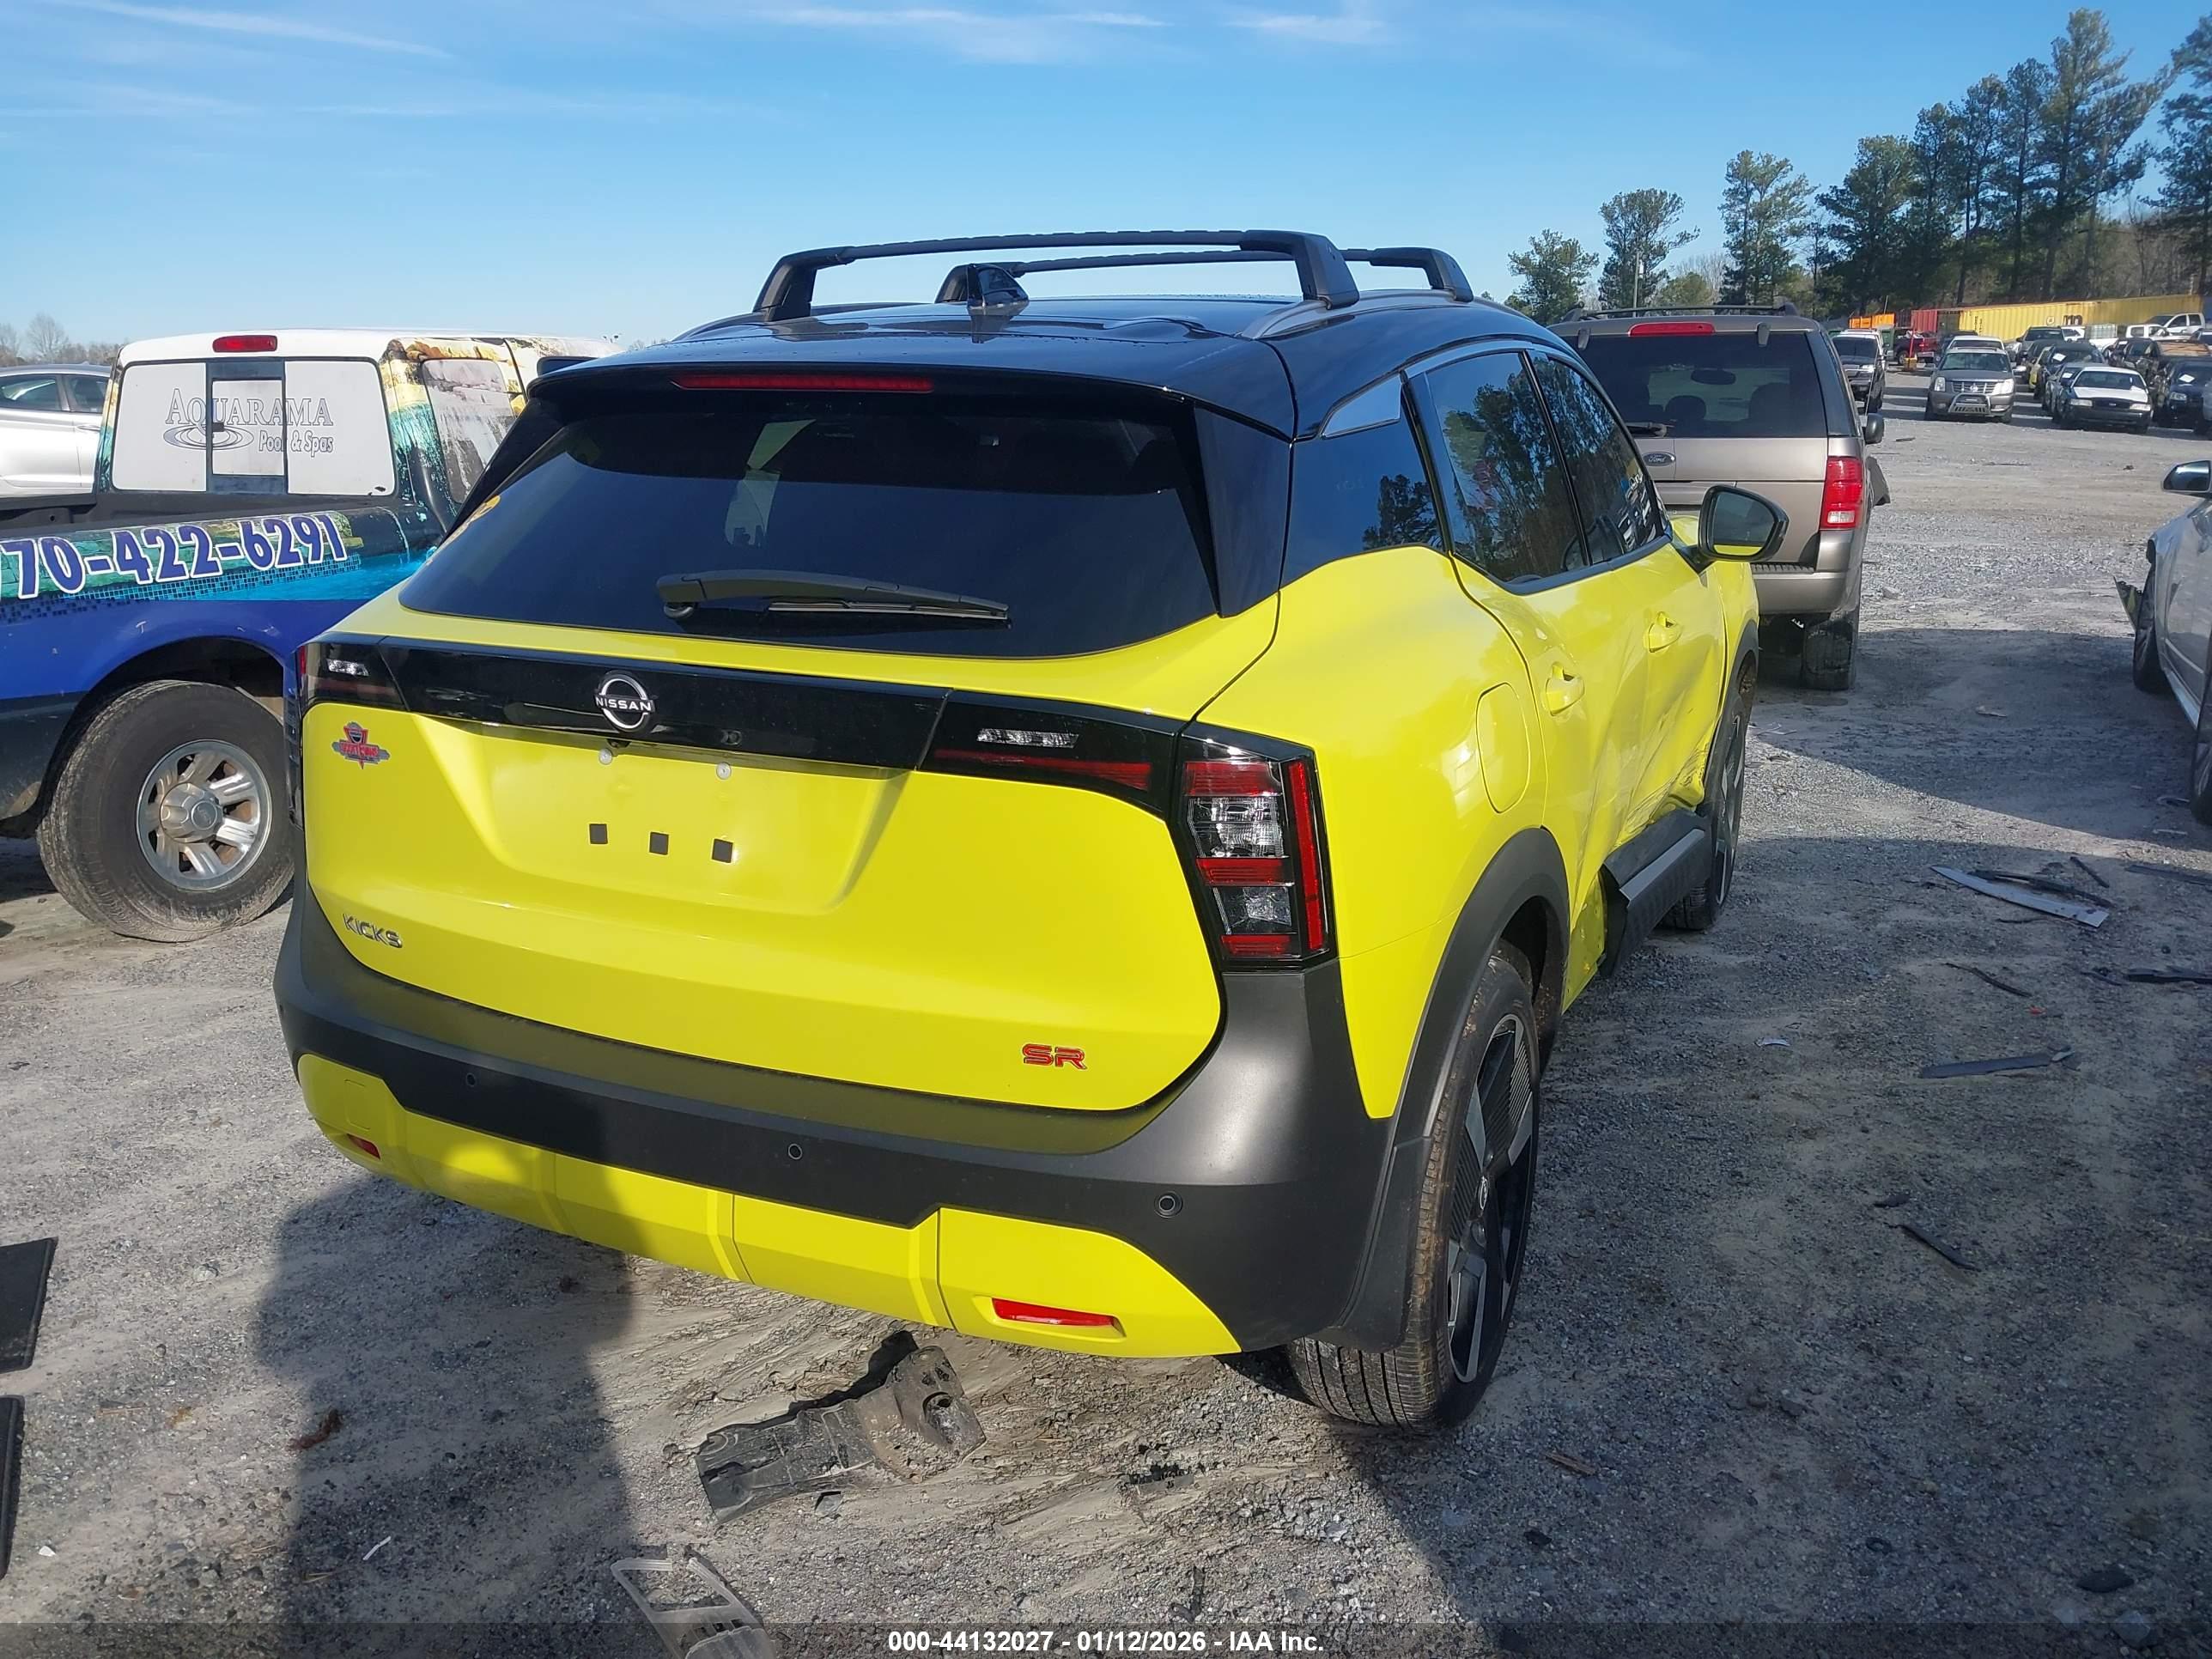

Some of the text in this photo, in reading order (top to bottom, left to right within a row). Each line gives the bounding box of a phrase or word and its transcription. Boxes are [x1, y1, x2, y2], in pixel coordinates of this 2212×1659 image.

[165, 387, 334, 435] AQUARAMA
[258, 429, 334, 458] Pool & Spas
[595, 696, 652, 711] NISSAN
[343, 913, 403, 949] KICKS
[1022, 1042, 1088, 1070] SR
